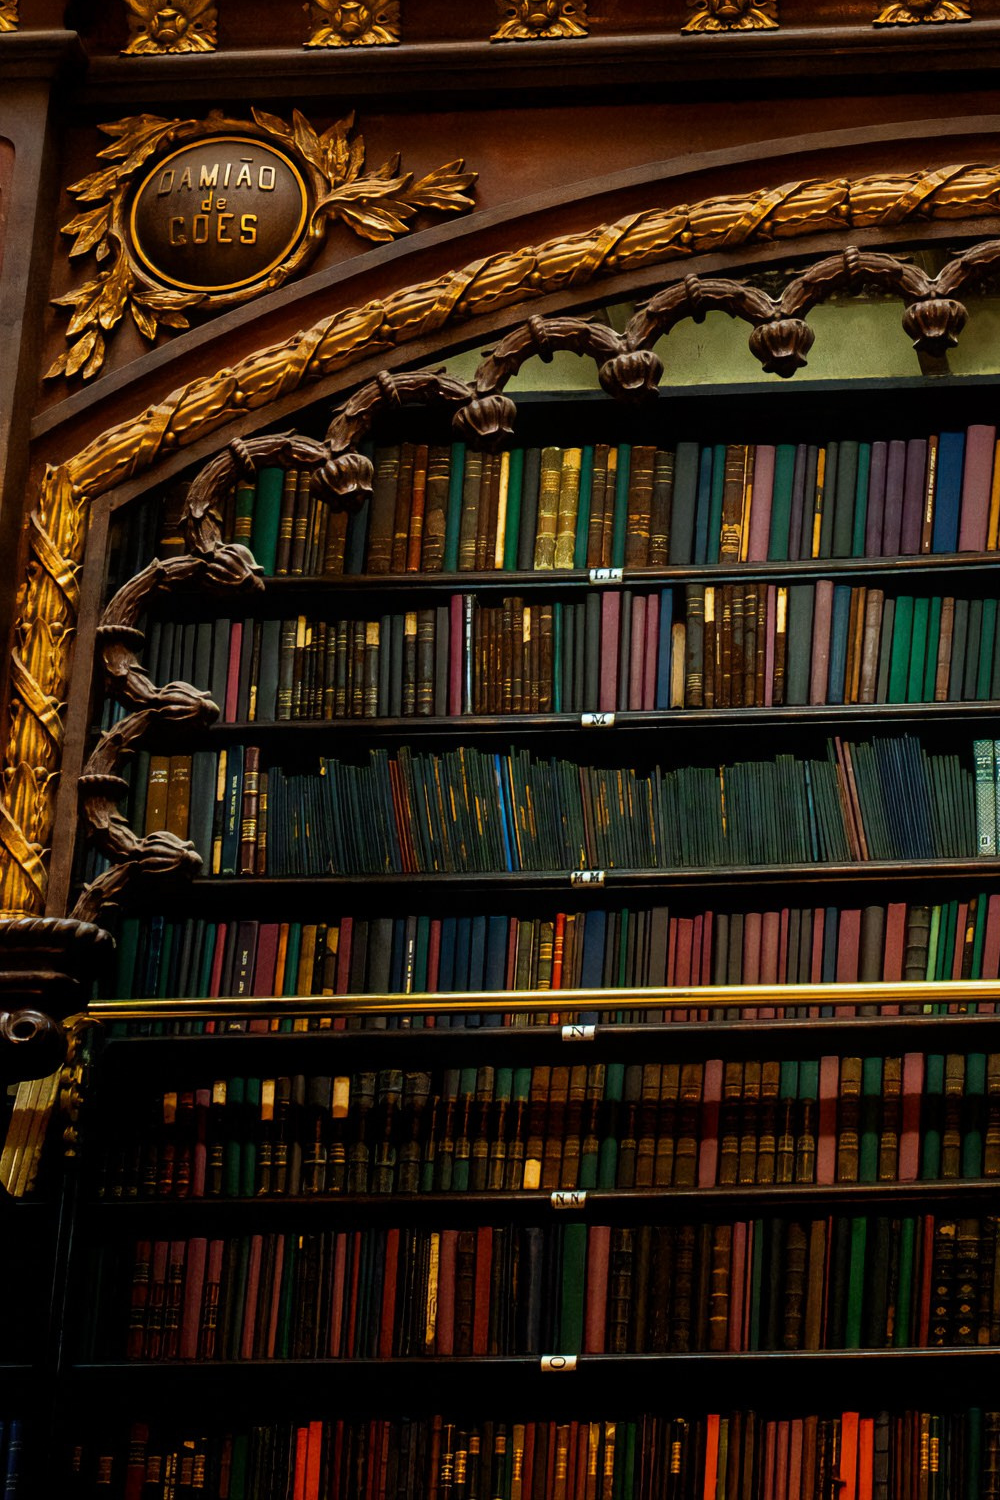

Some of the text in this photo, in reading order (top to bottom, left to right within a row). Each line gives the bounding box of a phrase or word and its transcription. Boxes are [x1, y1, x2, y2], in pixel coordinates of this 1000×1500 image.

[201, 189, 227, 211] de
[590, 714, 607, 725] M
[569, 1026, 585, 1038] N
